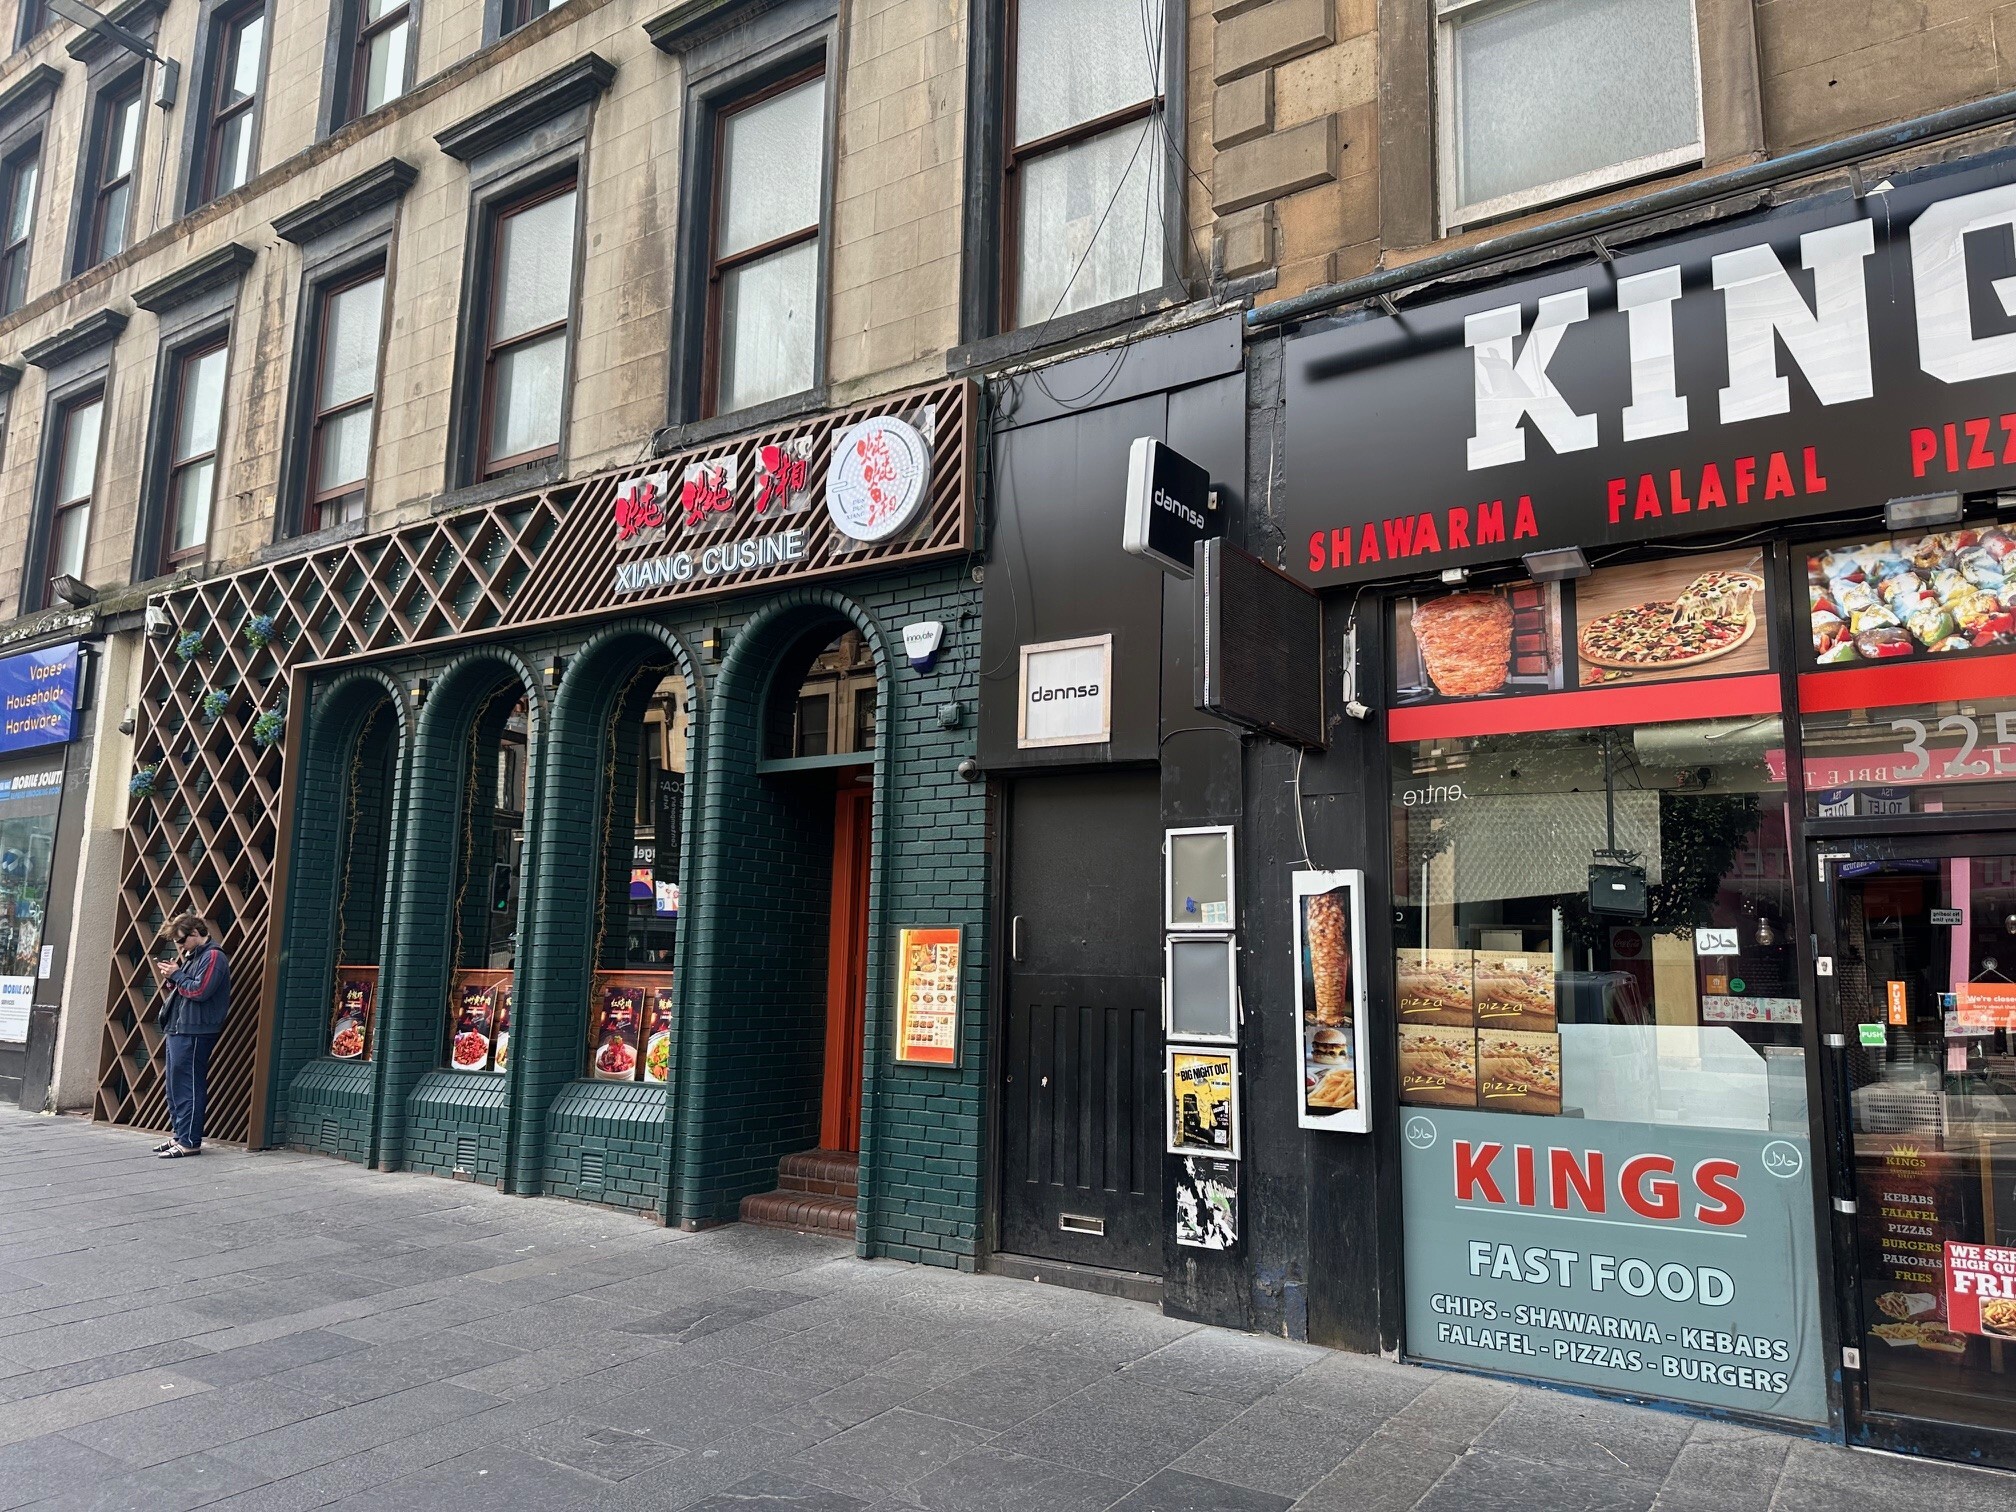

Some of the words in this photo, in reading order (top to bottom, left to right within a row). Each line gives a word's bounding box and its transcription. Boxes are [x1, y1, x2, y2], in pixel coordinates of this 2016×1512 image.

[1464, 185, 2016, 472] KING
[1154, 487, 1205, 530] dannsa
[1307, 495, 1539, 573] SHAWARMA
[1606, 446, 1827, 525] FALAFAL
[614, 551, 693, 594] XIANG
[702, 531, 805, 575] CUSINE
[1031, 683, 1099, 703] dannsa
[1700, 933, 1736, 950] حلال
[1400, 994, 1443, 1009] pizza
[1478, 998, 1523, 1013] pizza
[1892, 984, 1901, 1013] PUSH
[1180, 1069, 1193, 1081] BIG
[1193, 1065, 1214, 1079] NIGHT
[1214, 1063, 1229, 1075] OUT
[1403, 1071, 1447, 1086] pizza
[1482, 1078, 1528, 1093] pizza
[1886, 1157, 1926, 1167] KINGS
[1453, 1139, 1746, 1227] KINGS
[1883, 1192, 1934, 1205] KEBABS
[1881, 1207, 1939, 1222] FALAFEL
[1888, 1223, 1933, 1236] PIZZAS
[1881, 1237, 1942, 1253] BURGERS
[1949, 1244, 1980, 1260] WE
[1882, 1253, 1943, 1269] PAKORAS
[1950, 1257, 1990, 1272] HIGH
[1992, 1262, 2016, 1275] QU
[1468, 1240, 1579, 1288] FAST
[1589, 1253, 1735, 1307] FOOD
[1895, 1270, 1932, 1283] FRIES
[1953, 1270, 2016, 1299] FRI
[1430, 1293, 1498, 1320] CHIPS
[1514, 1304, 1662, 1345] SHAWARMA
[1681, 1327, 1790, 1362] KEBABS
[1437, 1322, 1536, 1357] FALAFEL
[1554, 1338, 1643, 1372] PIZZAS
[1661, 1355, 1789, 1394] BURGERS
